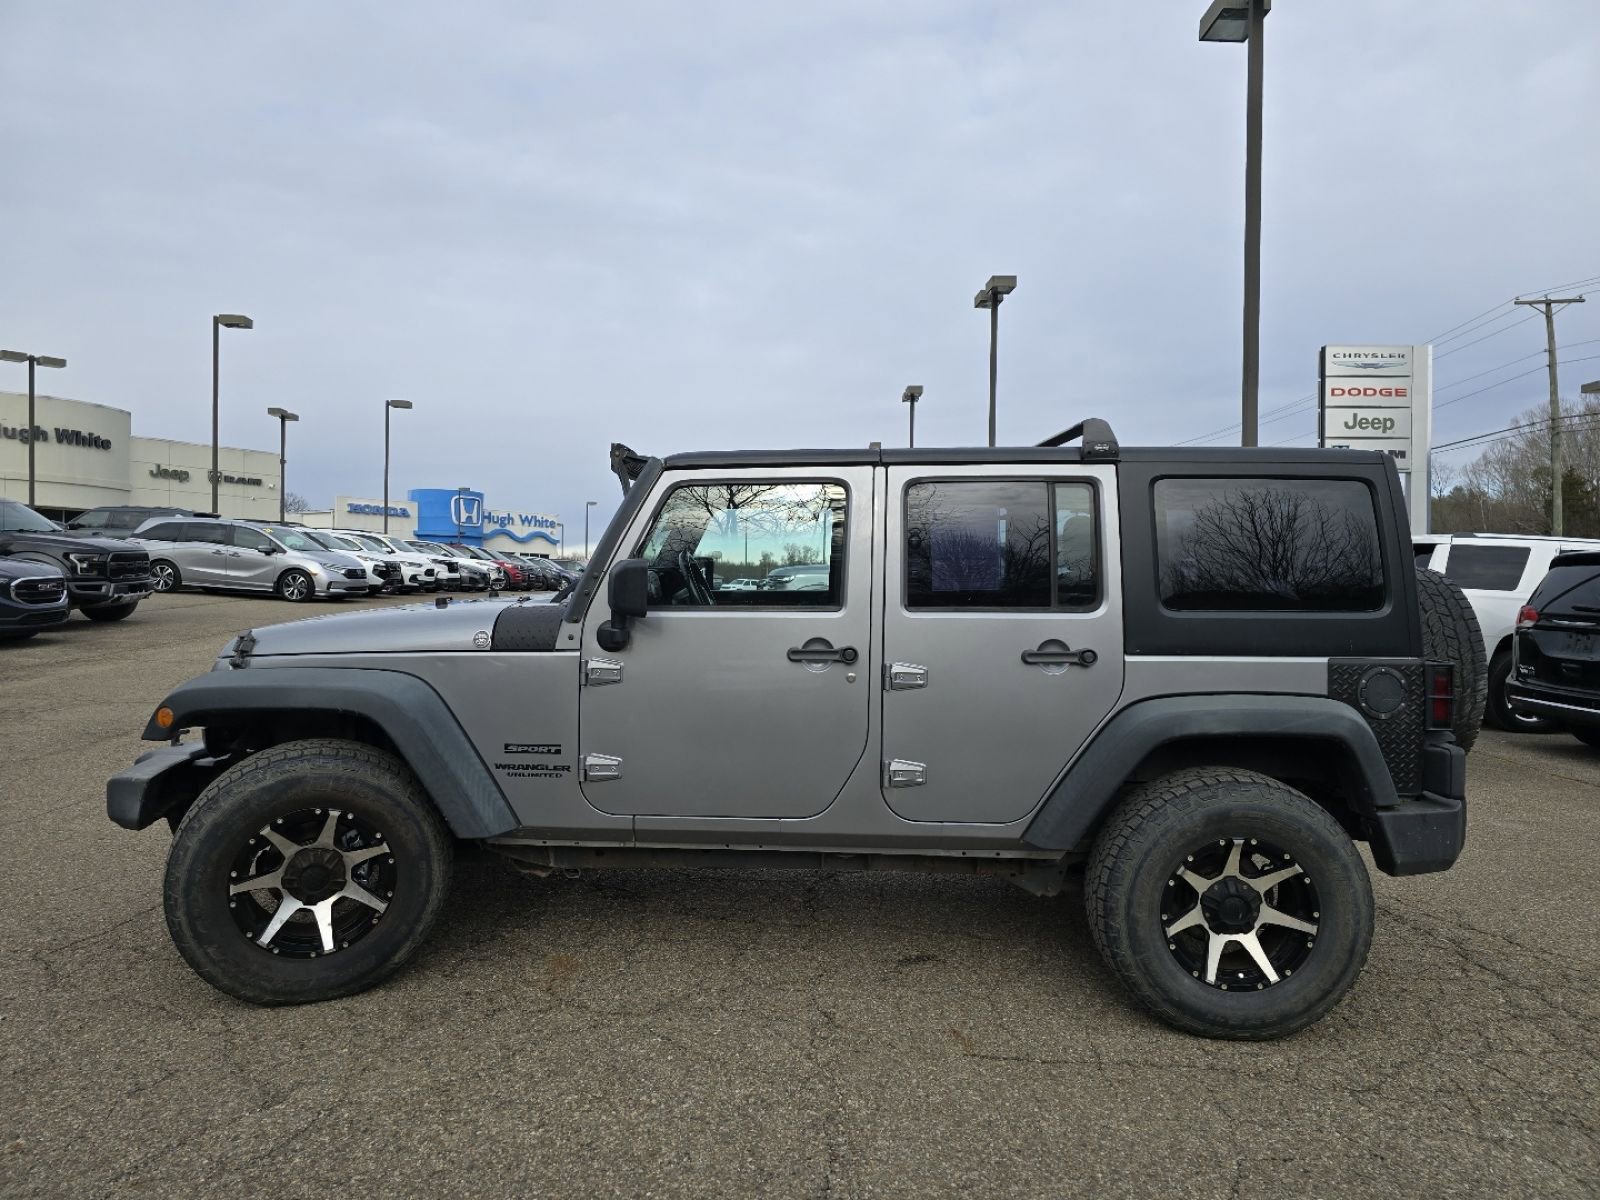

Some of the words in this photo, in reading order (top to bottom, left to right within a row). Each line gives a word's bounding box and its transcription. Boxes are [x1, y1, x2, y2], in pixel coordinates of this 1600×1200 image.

[1330, 387, 1407, 397] DODGE
[1344, 413, 1395, 433] Jeep
[0, 424, 48, 444] ugh
[54, 427, 112, 450] White
[148, 463, 190, 483] Jeep
[347, 502, 411, 518] HONDA
[482, 511, 514, 526] Hugh
[518, 513, 556, 528] White
[504, 745, 561, 753] SPORT
[494, 763, 571, 772] WRANGLER
